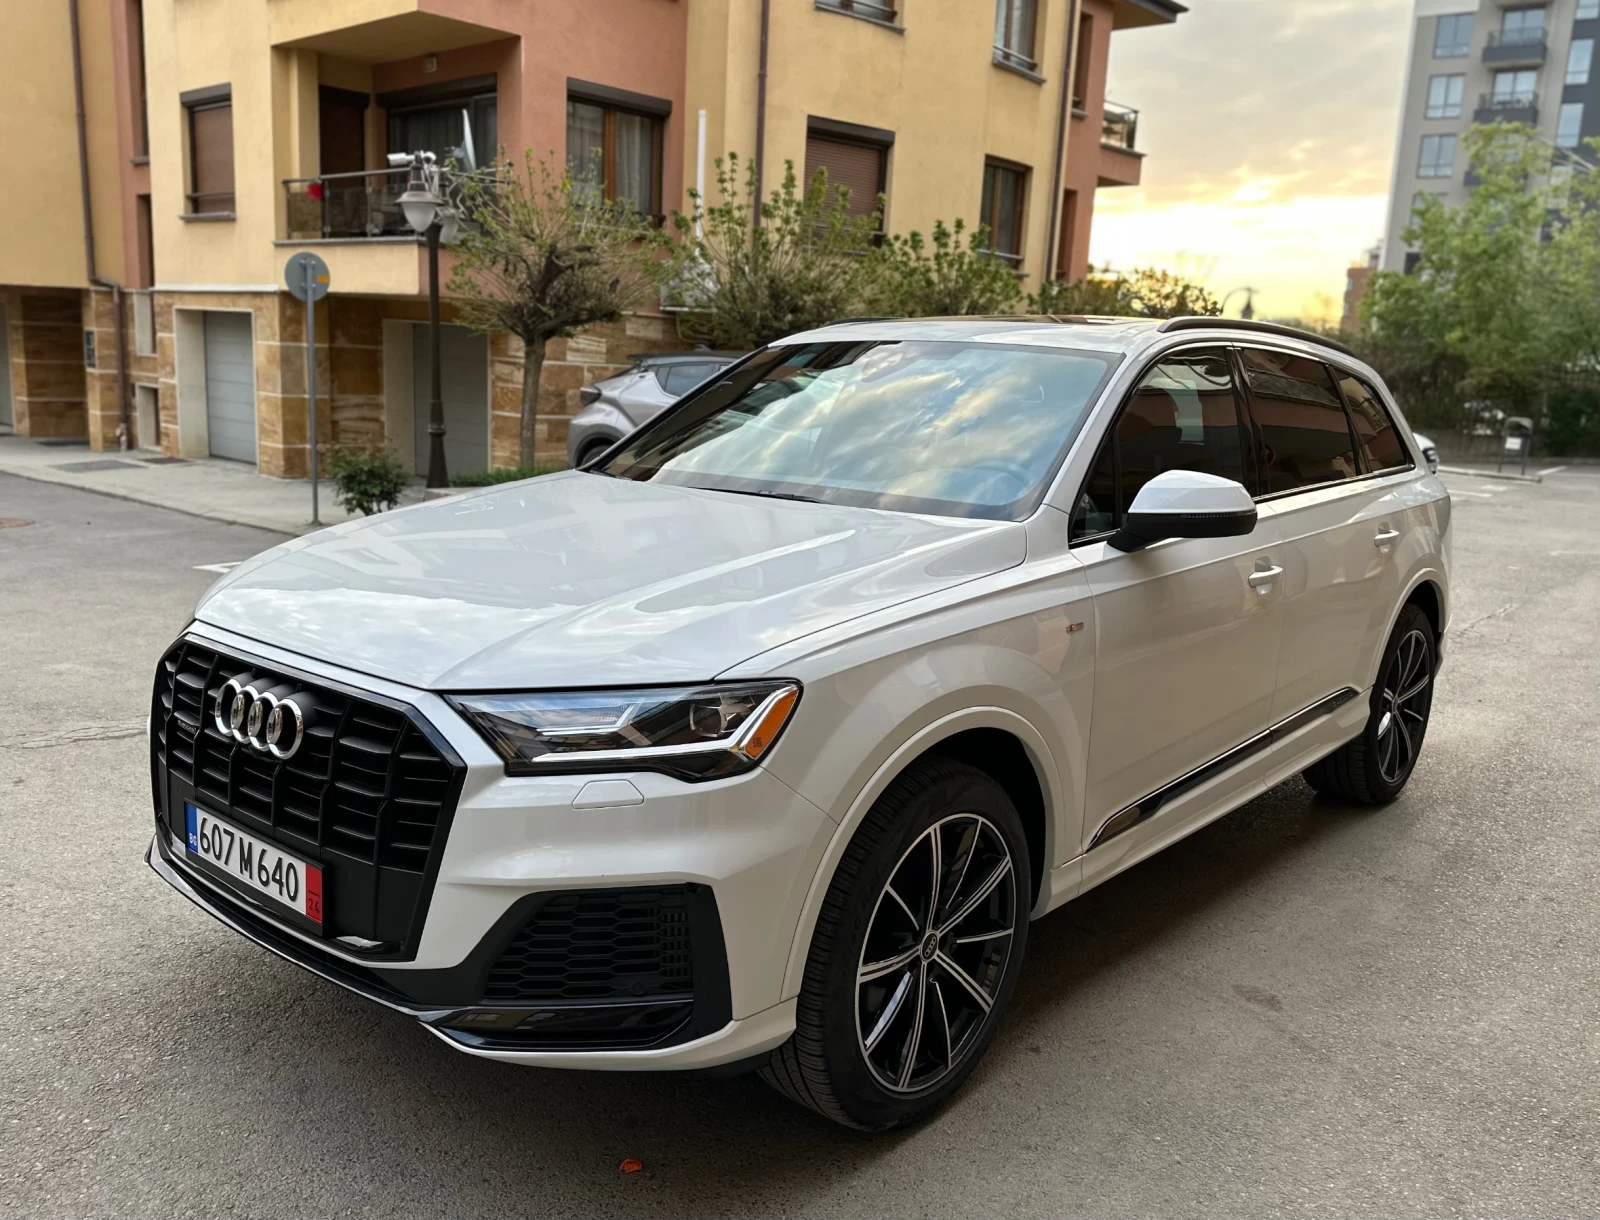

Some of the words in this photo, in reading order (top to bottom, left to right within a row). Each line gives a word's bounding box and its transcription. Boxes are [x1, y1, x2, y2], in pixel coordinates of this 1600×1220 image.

[189, 832, 197, 846] BG
[200, 817, 235, 866] 607
[239, 836, 253, 880] M
[257, 848, 299, 902] 640
[308, 897, 320, 914] 24
